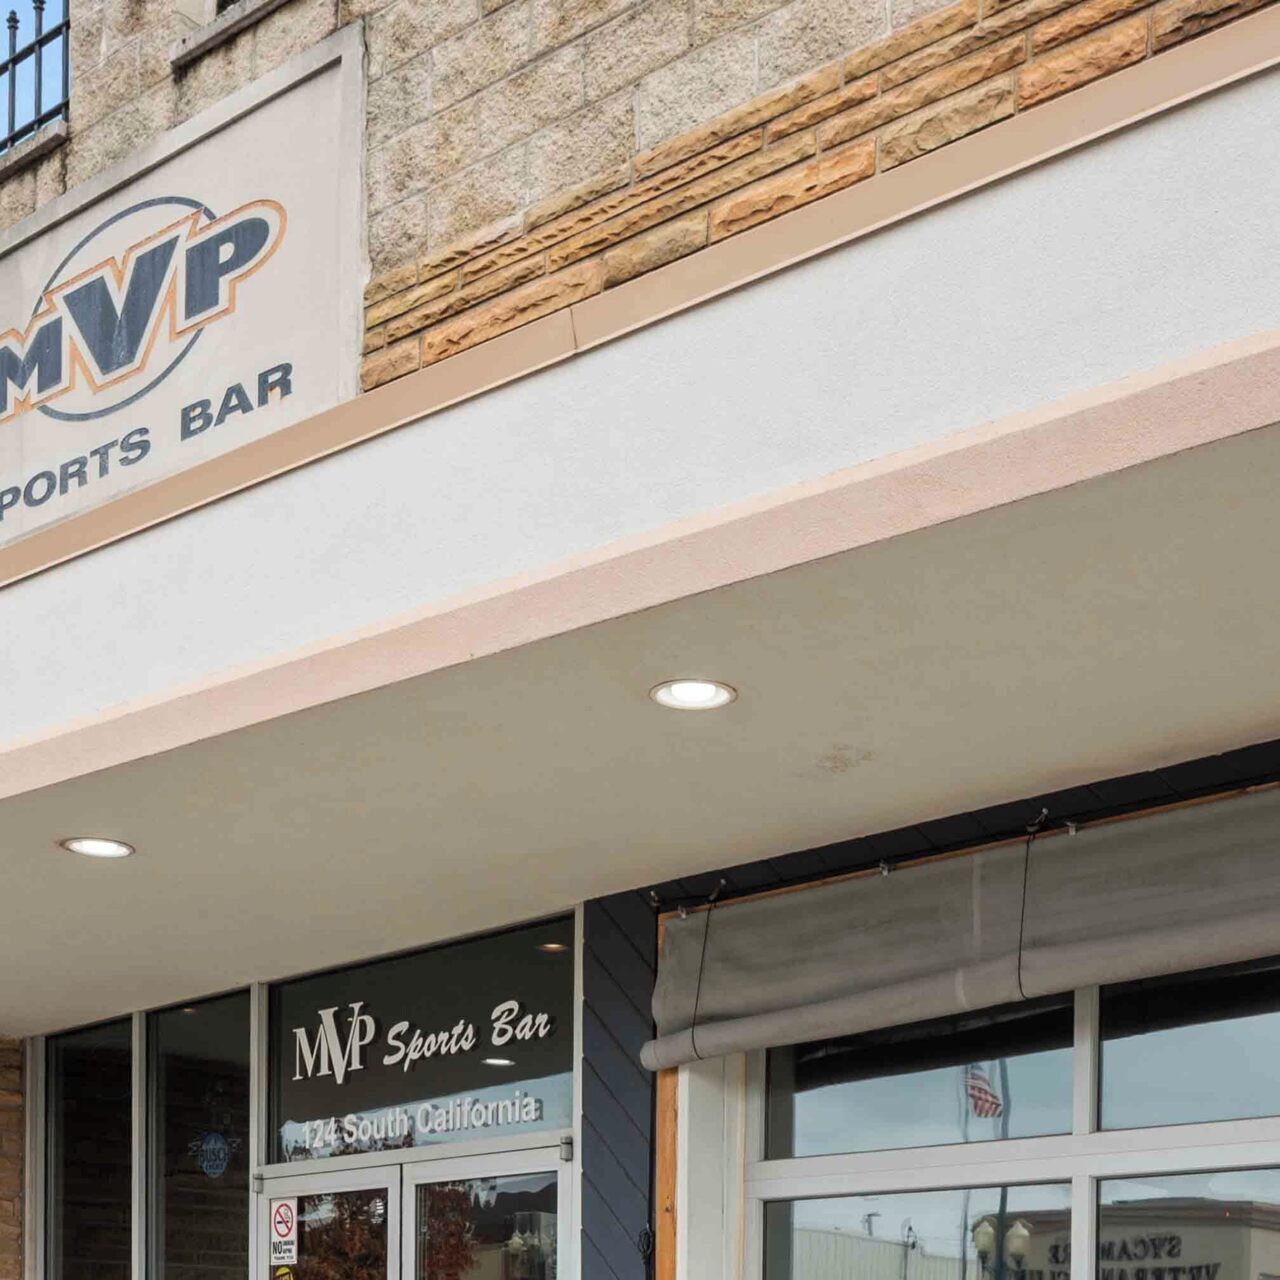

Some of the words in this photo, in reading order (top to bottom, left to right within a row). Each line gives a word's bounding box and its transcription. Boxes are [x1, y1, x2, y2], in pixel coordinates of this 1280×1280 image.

[180, 363, 293, 441] BAR
[292, 1001, 375, 1085] MVP
[383, 1019, 475, 1072] Sports
[491, 1000, 550, 1046] Bar
[302, 1117, 337, 1148] 124
[343, 1107, 410, 1143] South
[417, 1091, 539, 1133] California
[272, 1241, 282, 1255] NO
